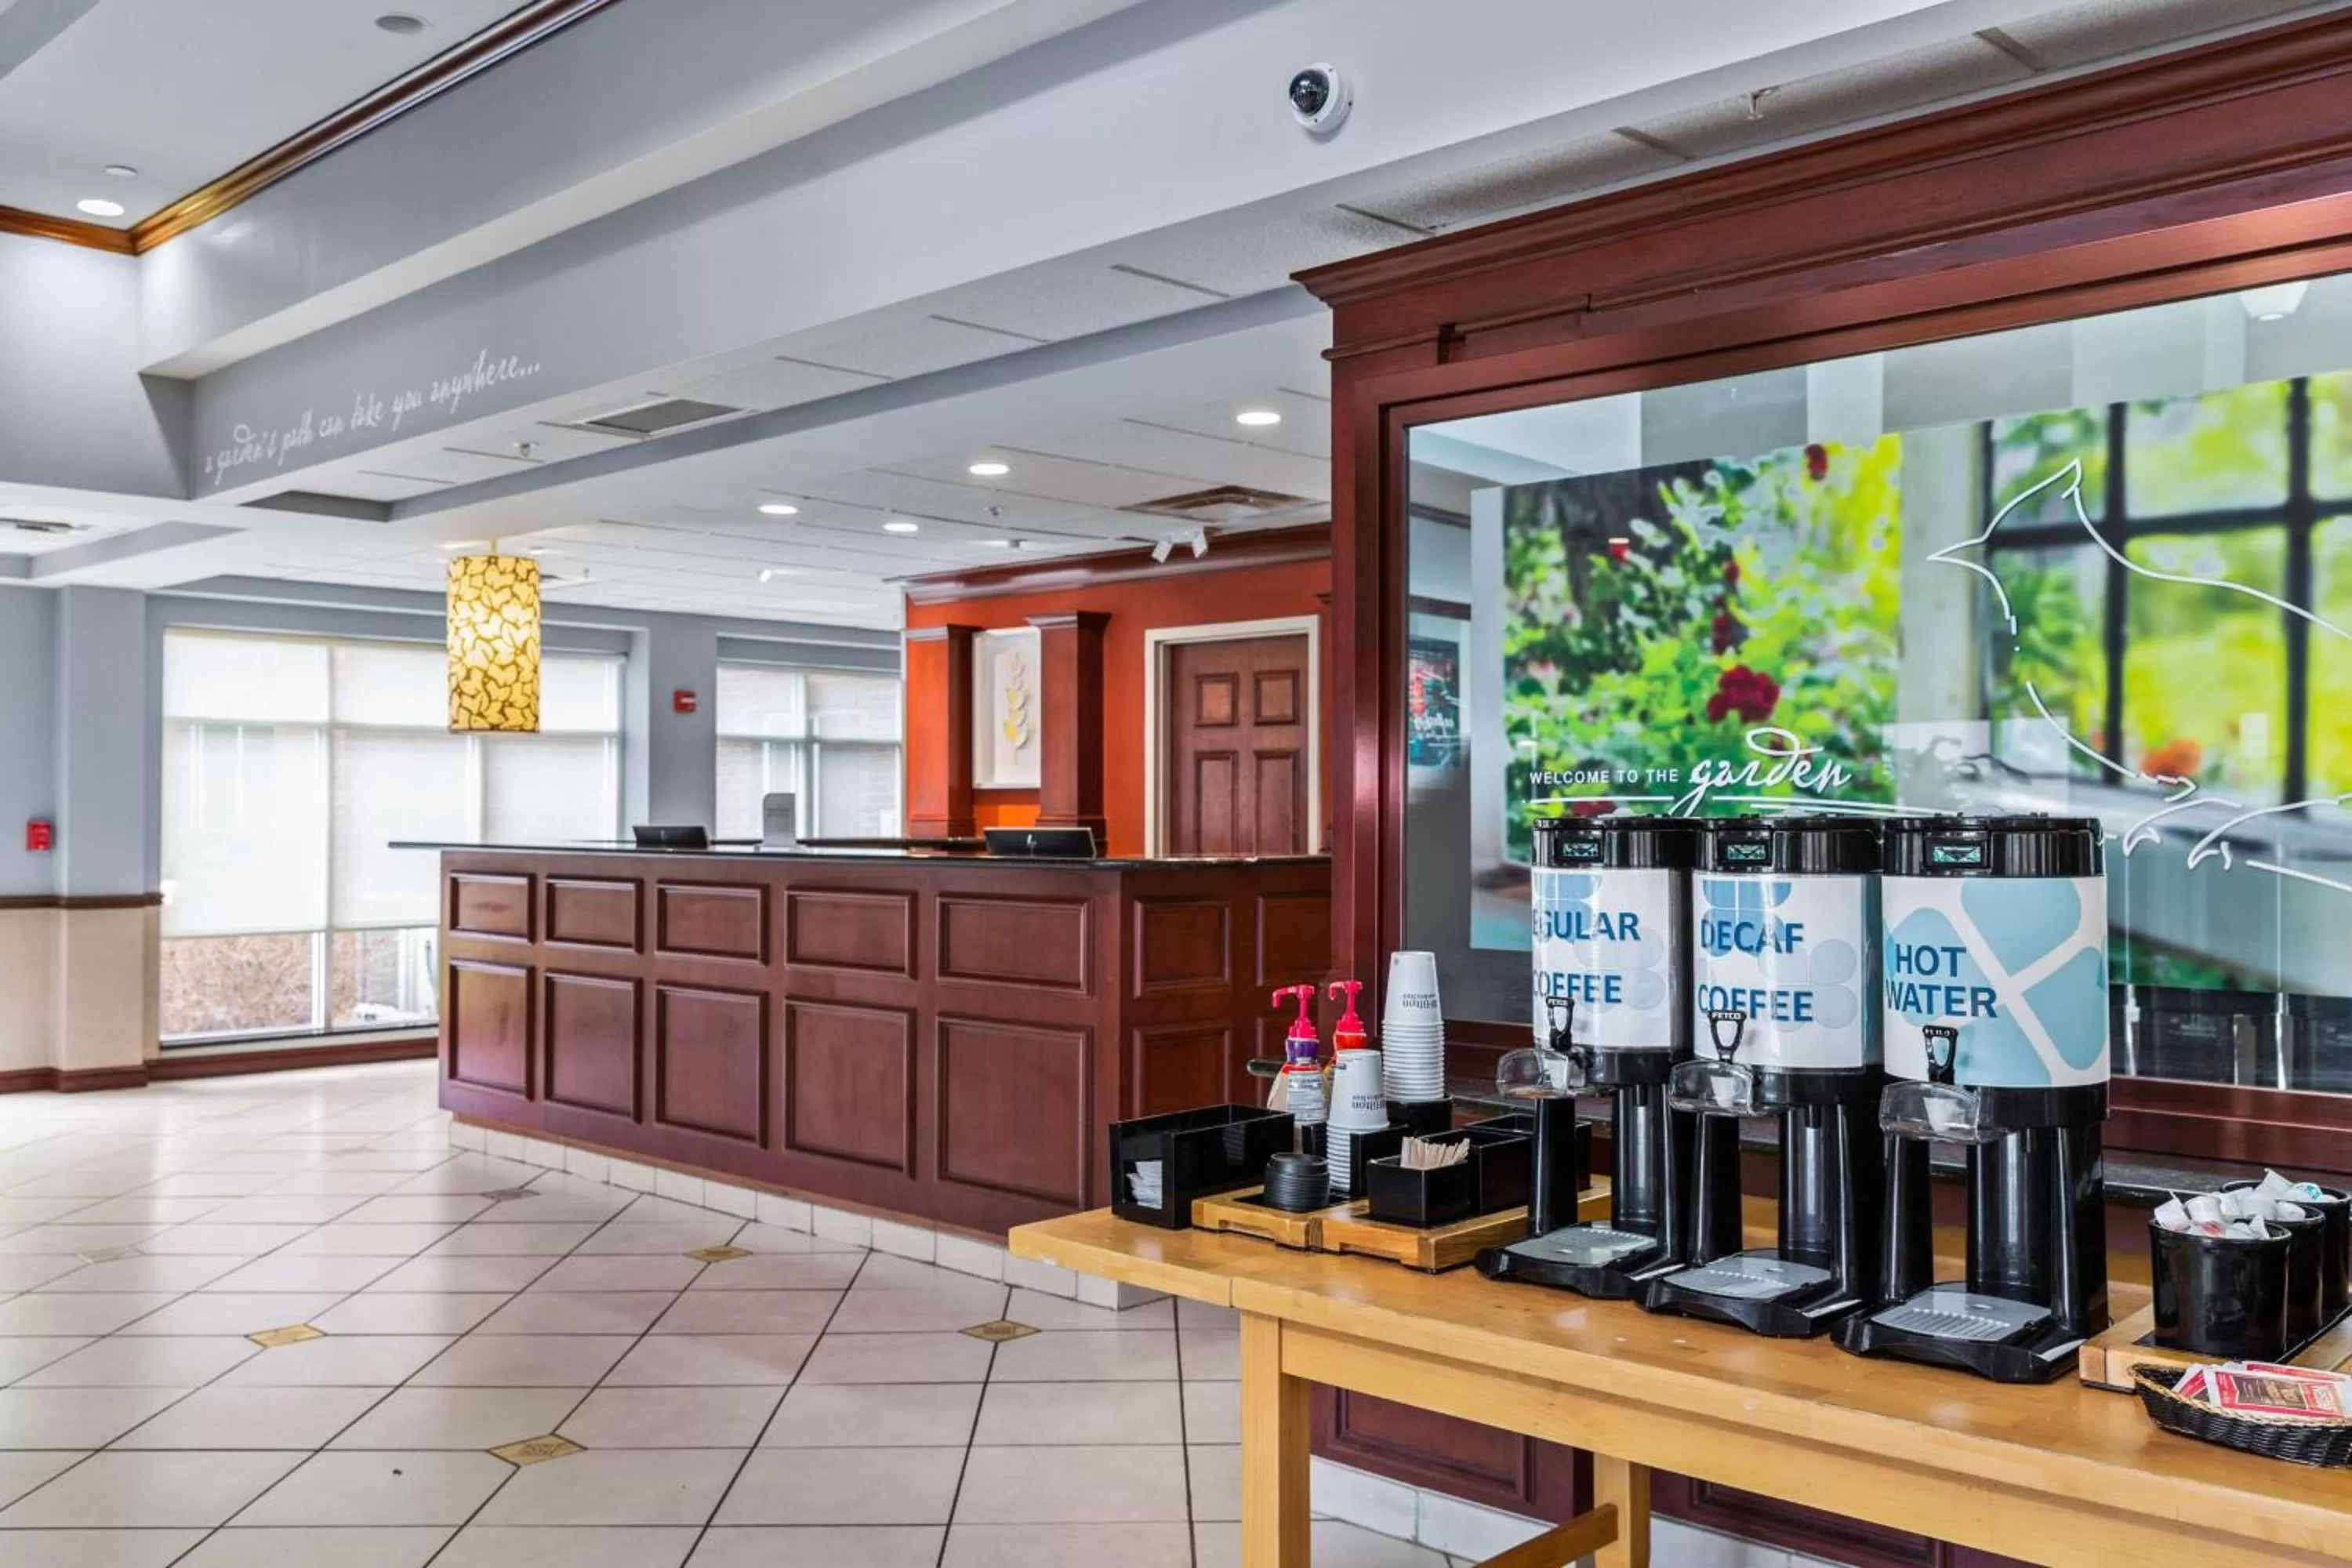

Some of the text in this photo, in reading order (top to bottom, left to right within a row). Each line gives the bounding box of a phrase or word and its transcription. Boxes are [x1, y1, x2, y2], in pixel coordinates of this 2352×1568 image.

[392, 390, 423, 433] you
[1530, 727, 1853, 817] WELCOME TO THE garden
[1700, 918, 1804, 954] DECAF
[1896, 943, 1967, 977] HOT
[1697, 984, 1813, 1022] COFFEE
[1886, 978, 1998, 1018] WATER
